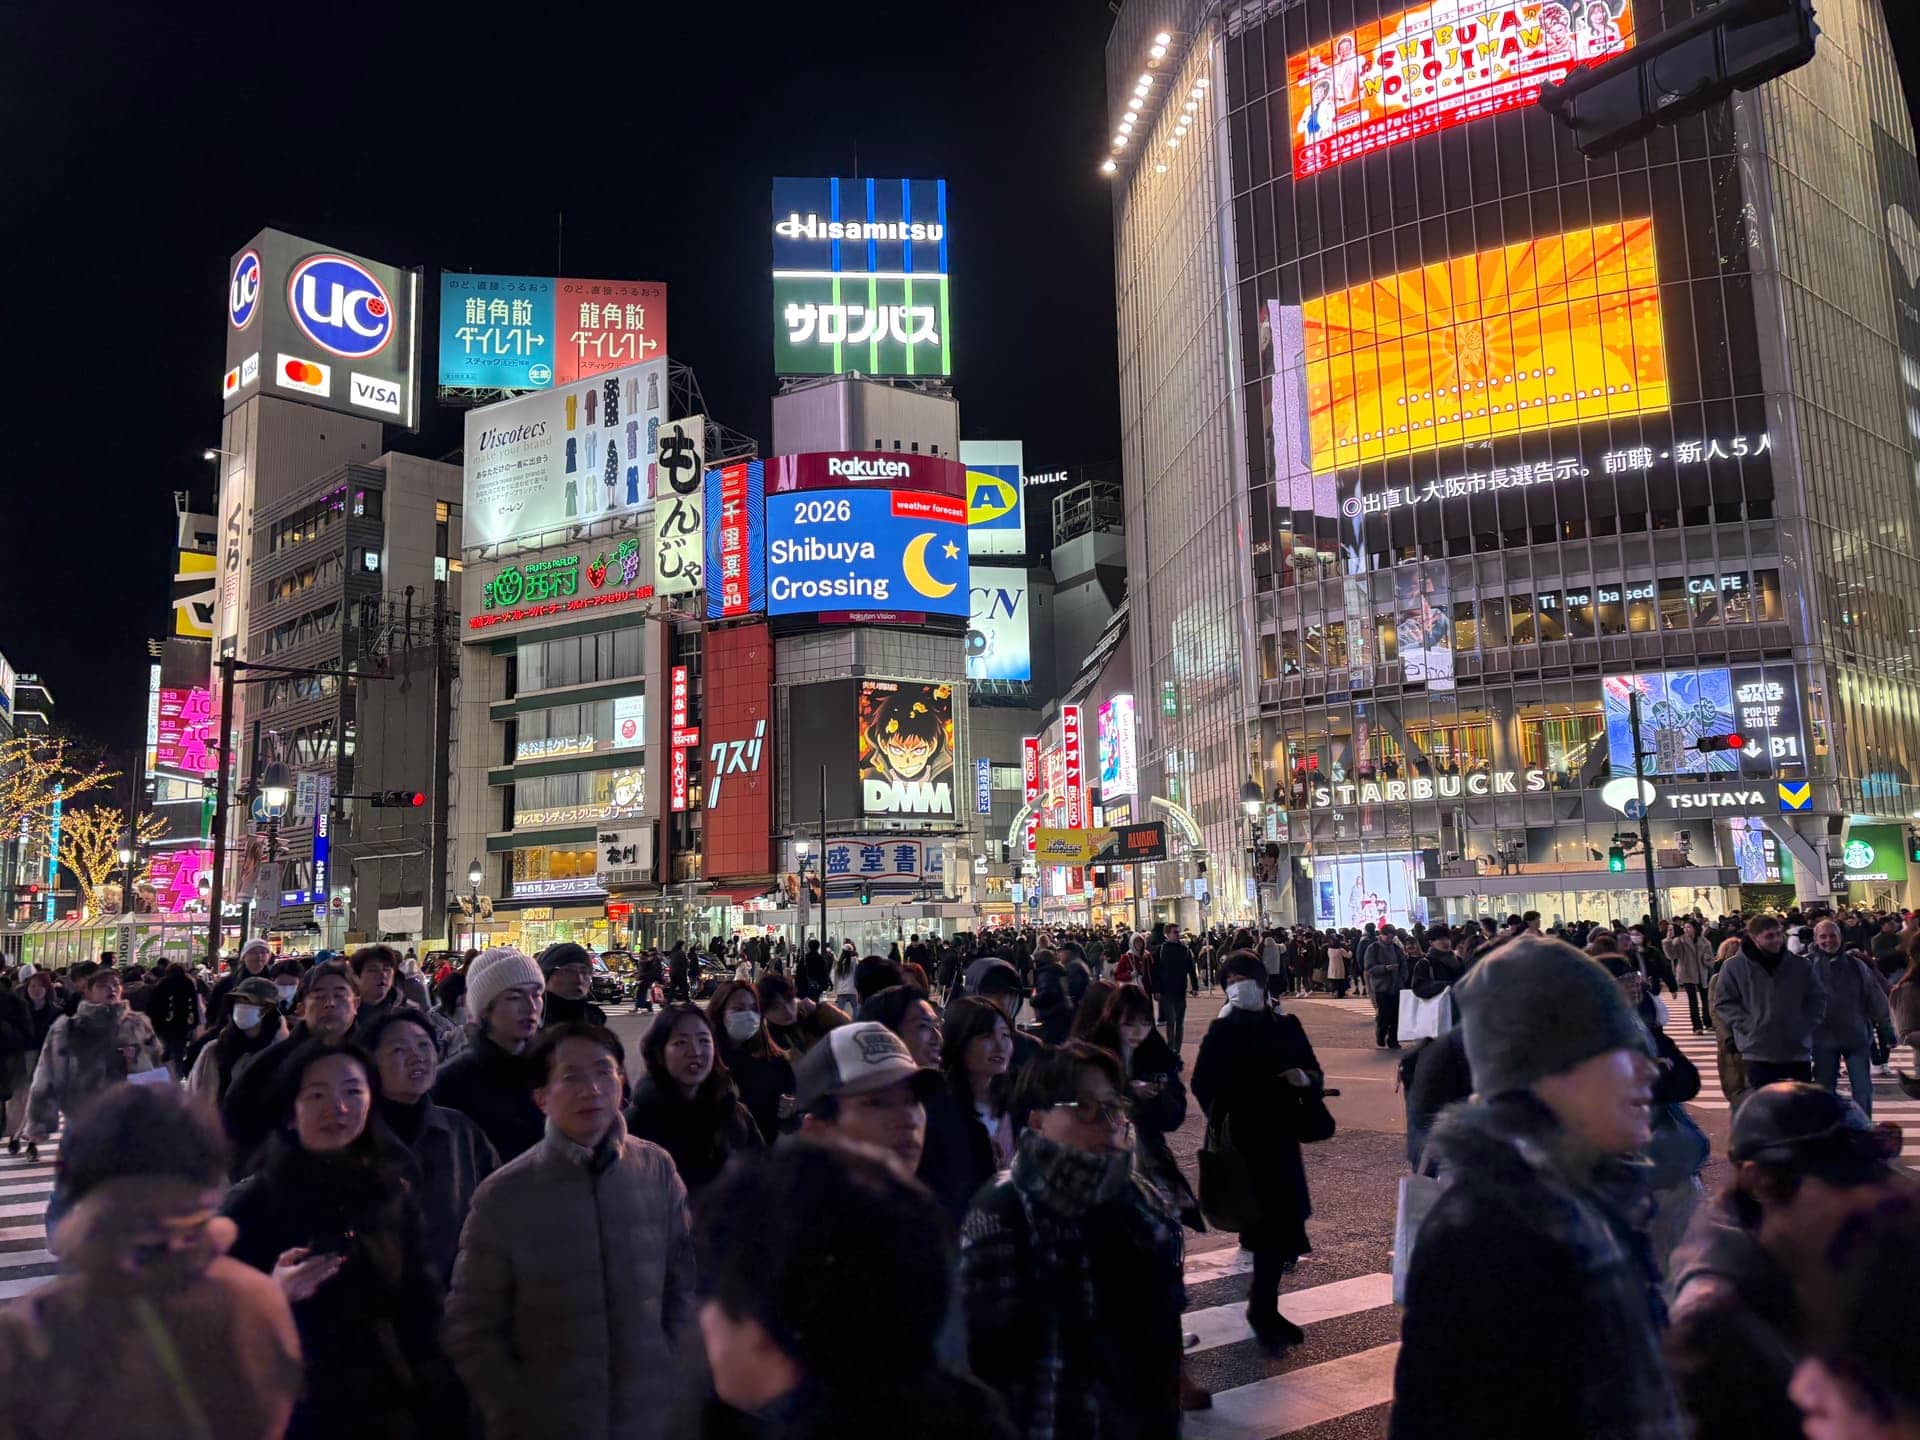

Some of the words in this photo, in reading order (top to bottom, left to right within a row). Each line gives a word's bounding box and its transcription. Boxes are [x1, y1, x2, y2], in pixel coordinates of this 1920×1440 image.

[1377, 10, 1522, 70] SHIBUYA
[1364, 26, 1541, 95] NODOJIMAN
[776, 213, 943, 241] Hisamitsu
[303, 274, 384, 337] UC
[465, 297, 533, 326] 龍角散
[580, 302, 645, 330] 龍角散
[785, 303, 939, 345] サロンパス
[455, 327, 545, 355] ダイレクト
[570, 331, 657, 359] ダイレクト
[355, 381, 398, 405] VISA
[480, 421, 547, 451] Viscotecs
[500, 446, 520, 459] your
[523, 435, 552, 451] brand
[828, 457, 910, 479] Rakuten
[1030, 472, 1067, 485] HULIC
[659, 424, 702, 586] もんじゃ
[794, 500, 850, 524] 2026
[897, 502, 930, 513] weather
[932, 504, 963, 517] forecast
[771, 537, 875, 564] Shibuya
[524, 567, 577, 601] 西村
[771, 572, 889, 600] Crossing
[1599, 585, 1654, 602] based
[1689, 576, 1742, 594] CAFE
[877, 612, 896, 620] Vision
[1744, 706, 1780, 717] POP-UP
[1065, 715, 1080, 778] カラオケ
[1771, 737, 1798, 757] B1
[708, 719, 766, 809] クスリ
[864, 779, 952, 813] DMM
[1316, 770, 1546, 807] STARBUCKS
[1667, 791, 1765, 809] TSUTAYA
[1127, 830, 1160, 848] ALVARK
